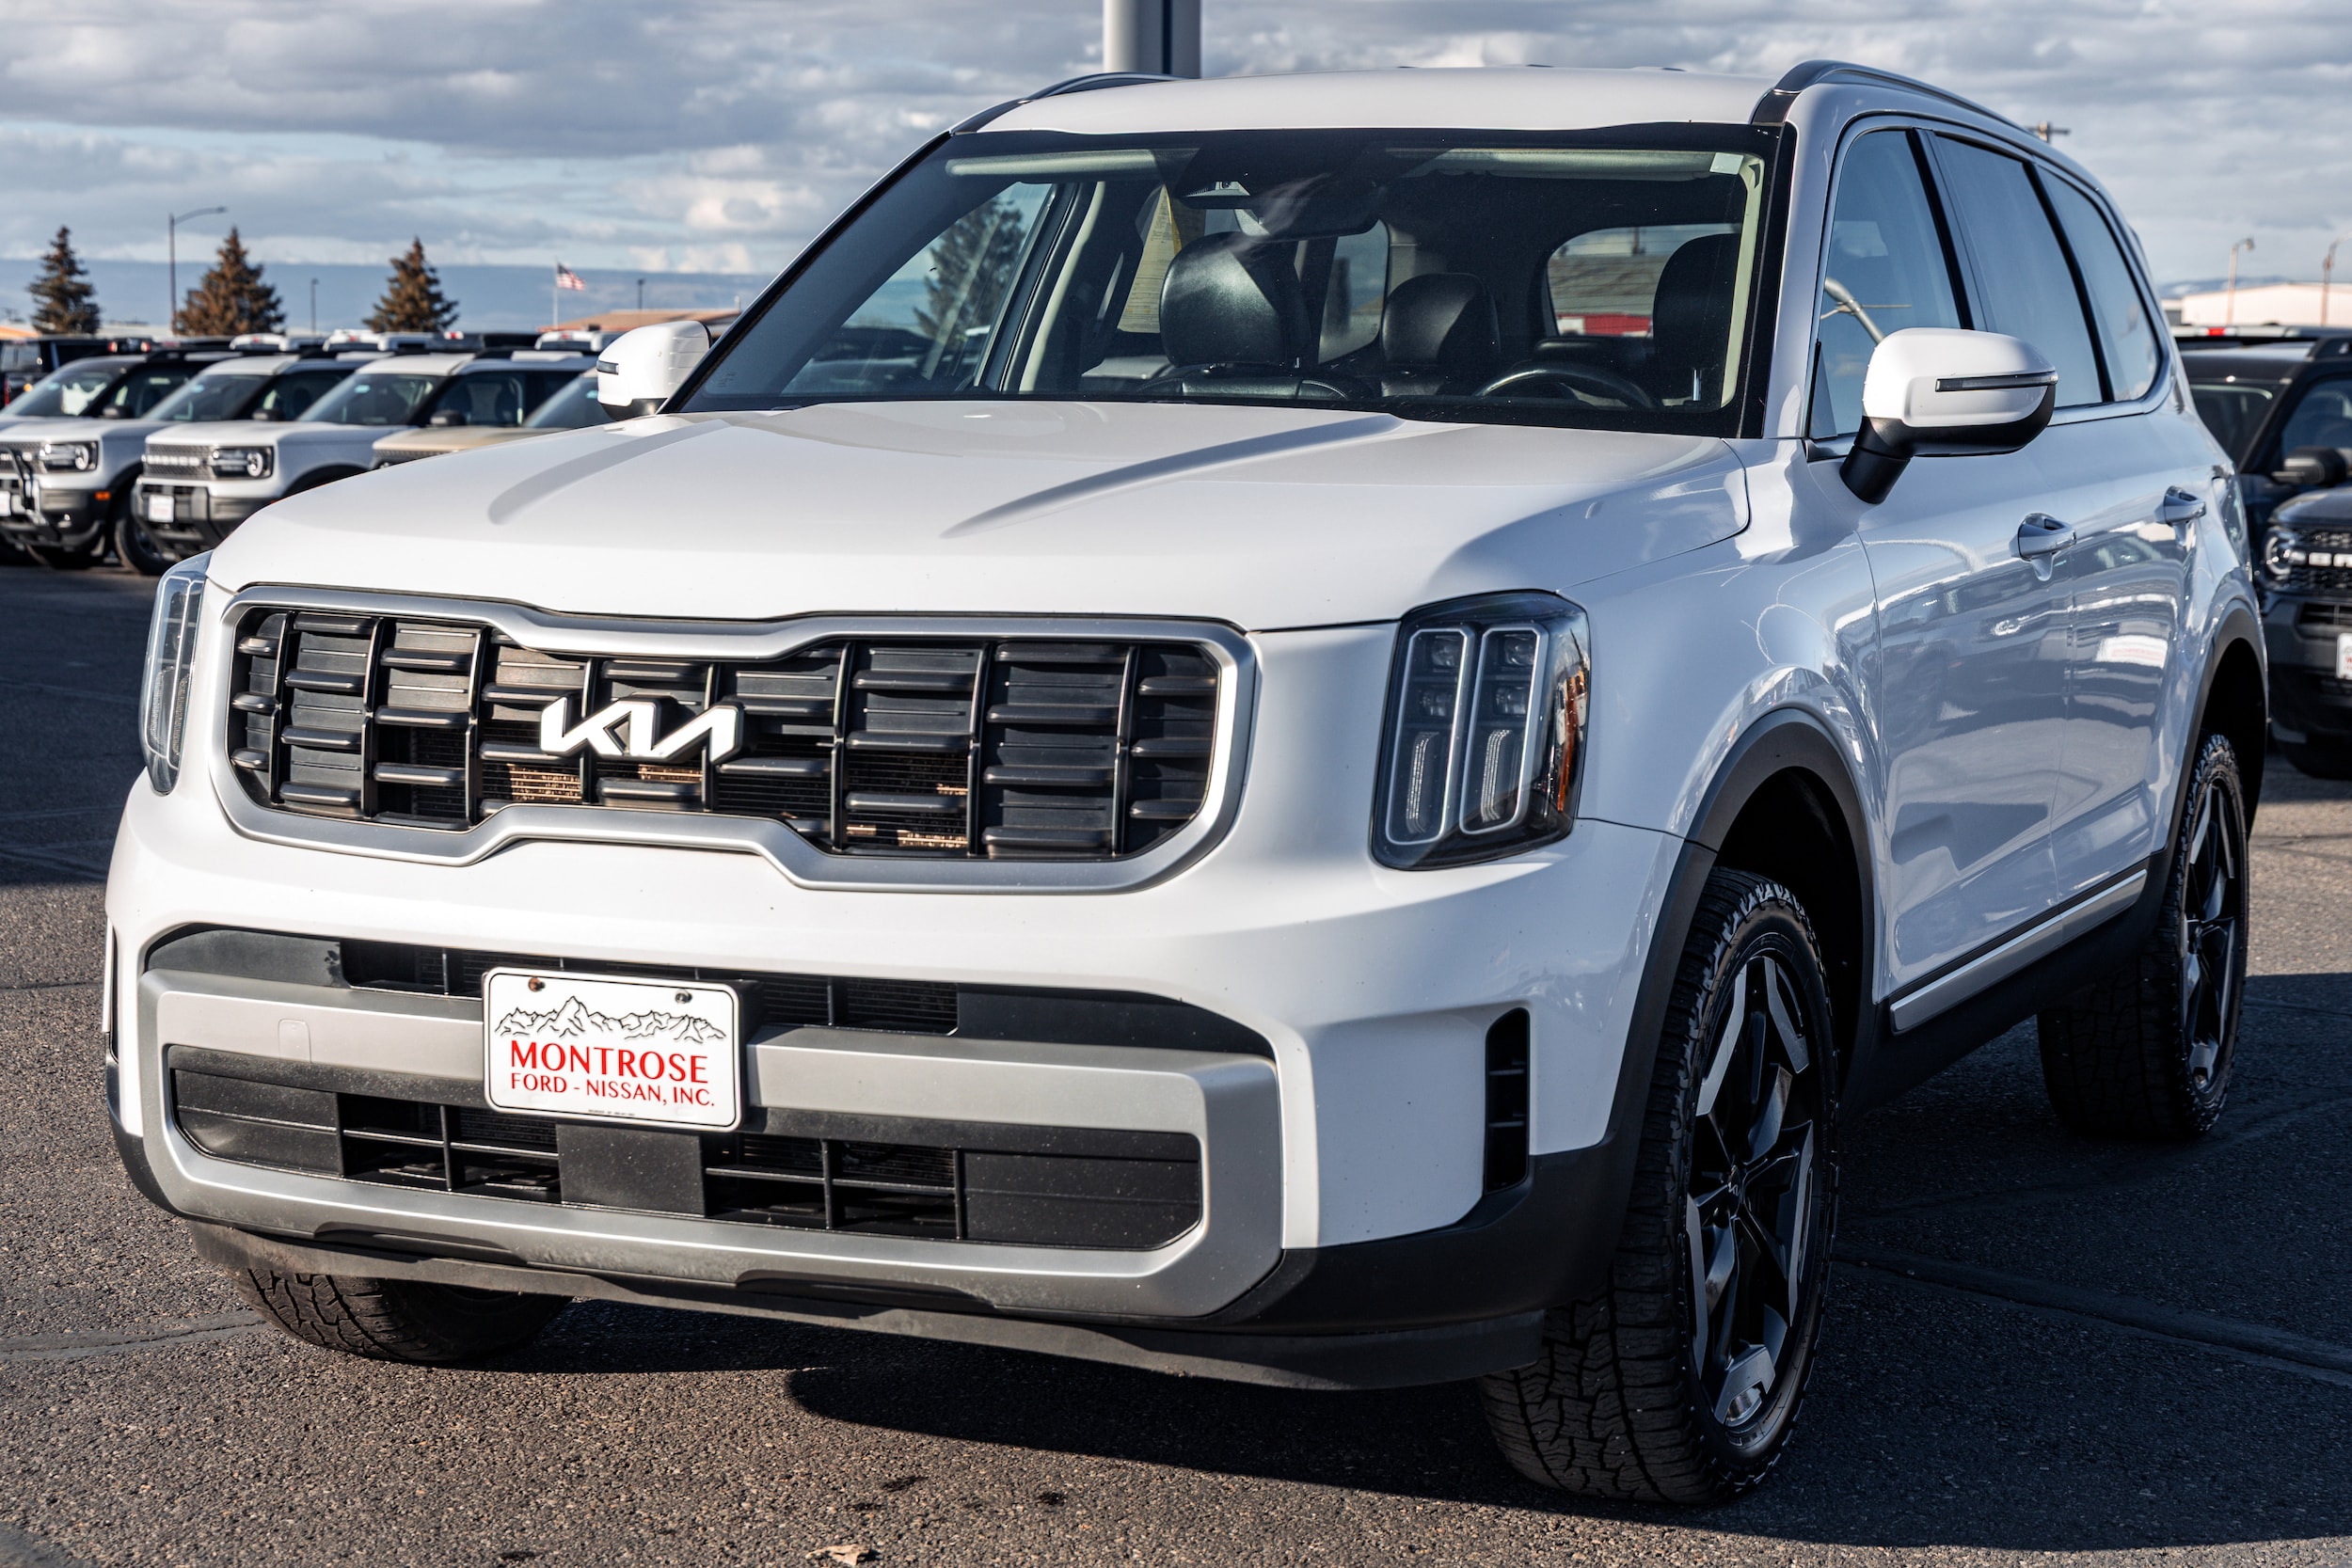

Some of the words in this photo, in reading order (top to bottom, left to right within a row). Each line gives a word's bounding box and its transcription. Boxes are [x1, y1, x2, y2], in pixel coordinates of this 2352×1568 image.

[540, 696, 739, 764] KIA
[511, 1039, 708, 1084] MONTROSE
[511, 1072, 568, 1094] FORD
[586, 1079, 668, 1106] NISSAN,
[673, 1085, 715, 1107] INC.
